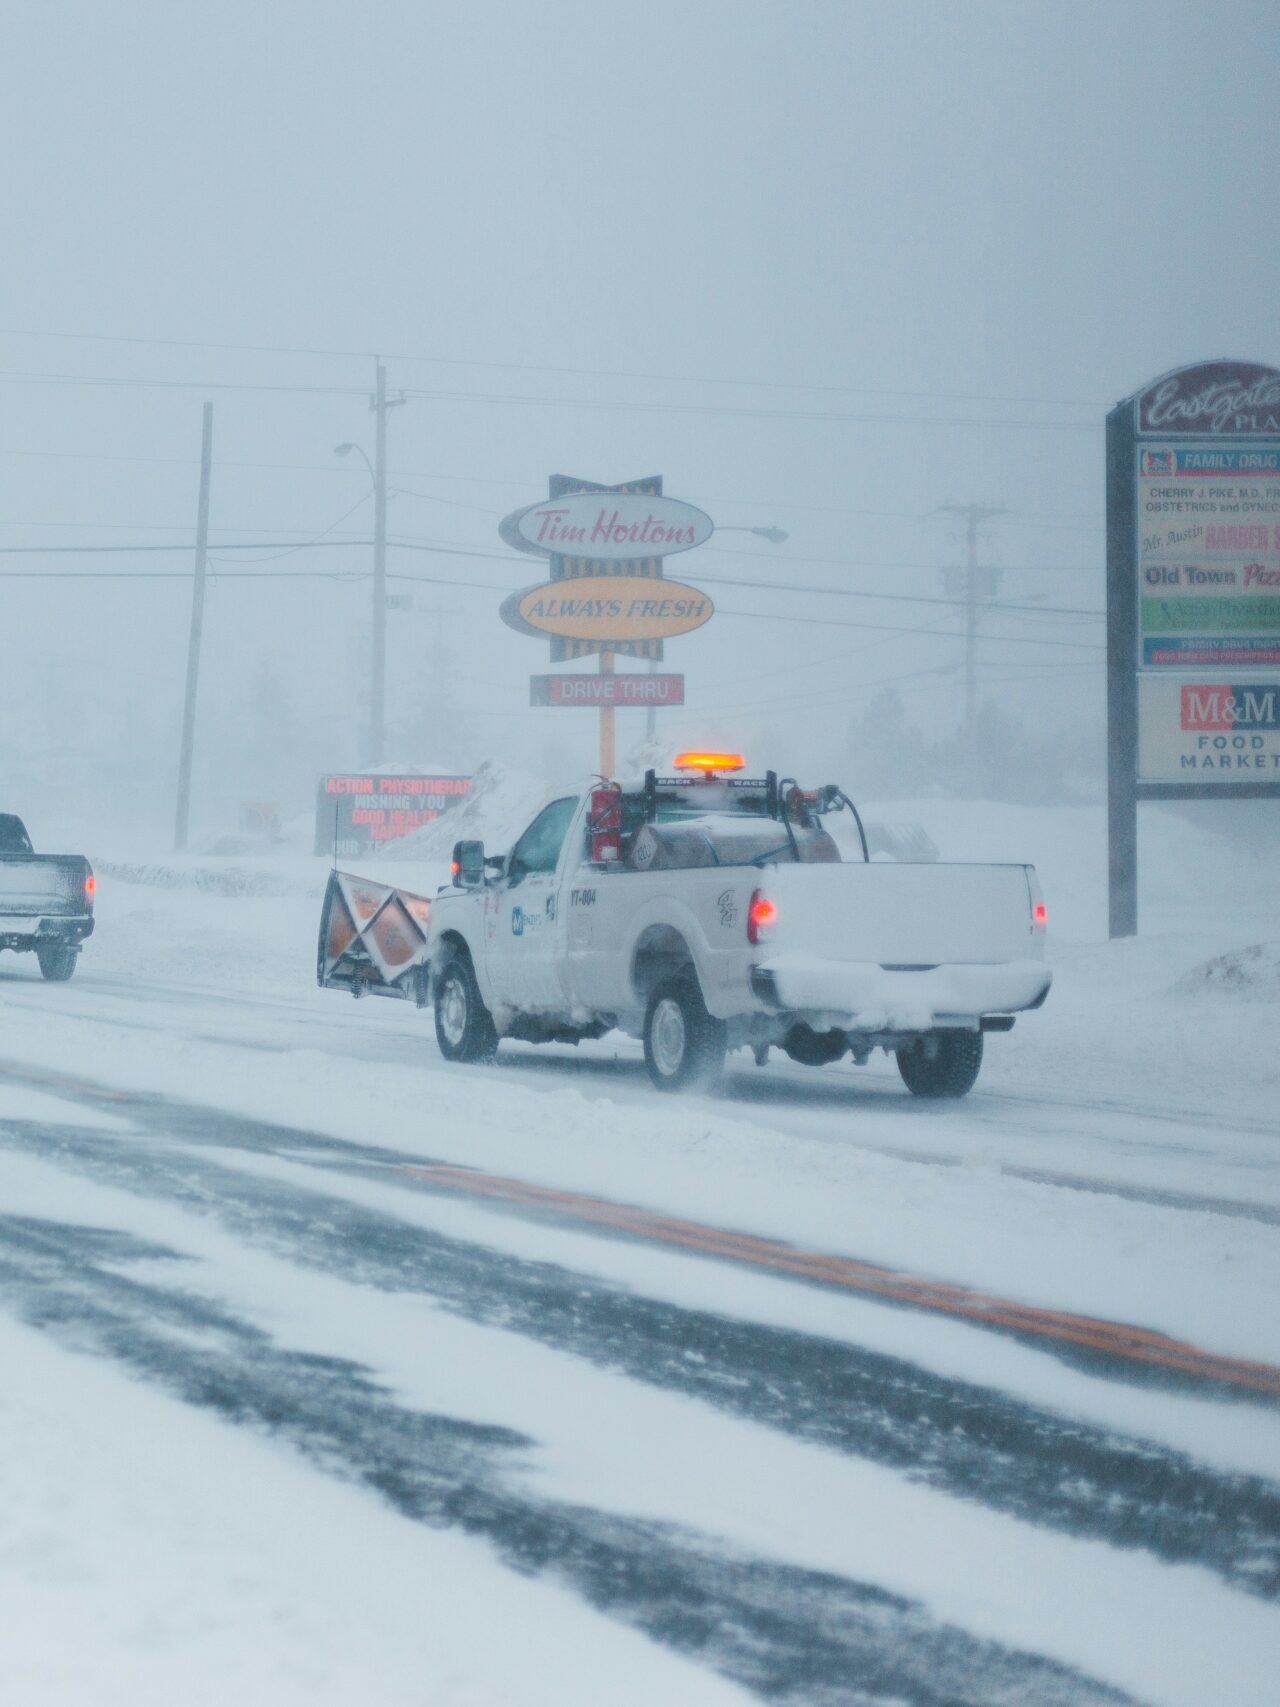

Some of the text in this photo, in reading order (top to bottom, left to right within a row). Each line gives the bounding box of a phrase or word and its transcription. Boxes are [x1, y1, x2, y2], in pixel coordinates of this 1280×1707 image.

[1184, 453, 1278, 468] FAMILY DRUG
[1150, 488, 1195, 498] CHERRY
[1145, 502, 1280, 512] OBSTETRICS and GYNEC
[535, 508, 696, 544] Tim Hortons
[1145, 567, 1179, 584] Old
[1184, 567, 1236, 585] Town
[528, 599, 706, 617] ALWAYS FRESH
[562, 682, 668, 698] DRIVE THRU
[1187, 692, 1276, 722] M&M
[1198, 736, 1265, 749] FOOD
[1181, 755, 1280, 768] MARKET
[326, 777, 373, 793] ACTION
[355, 794, 445, 810] WISHING YOU
[352, 809, 384, 824] GOOD
